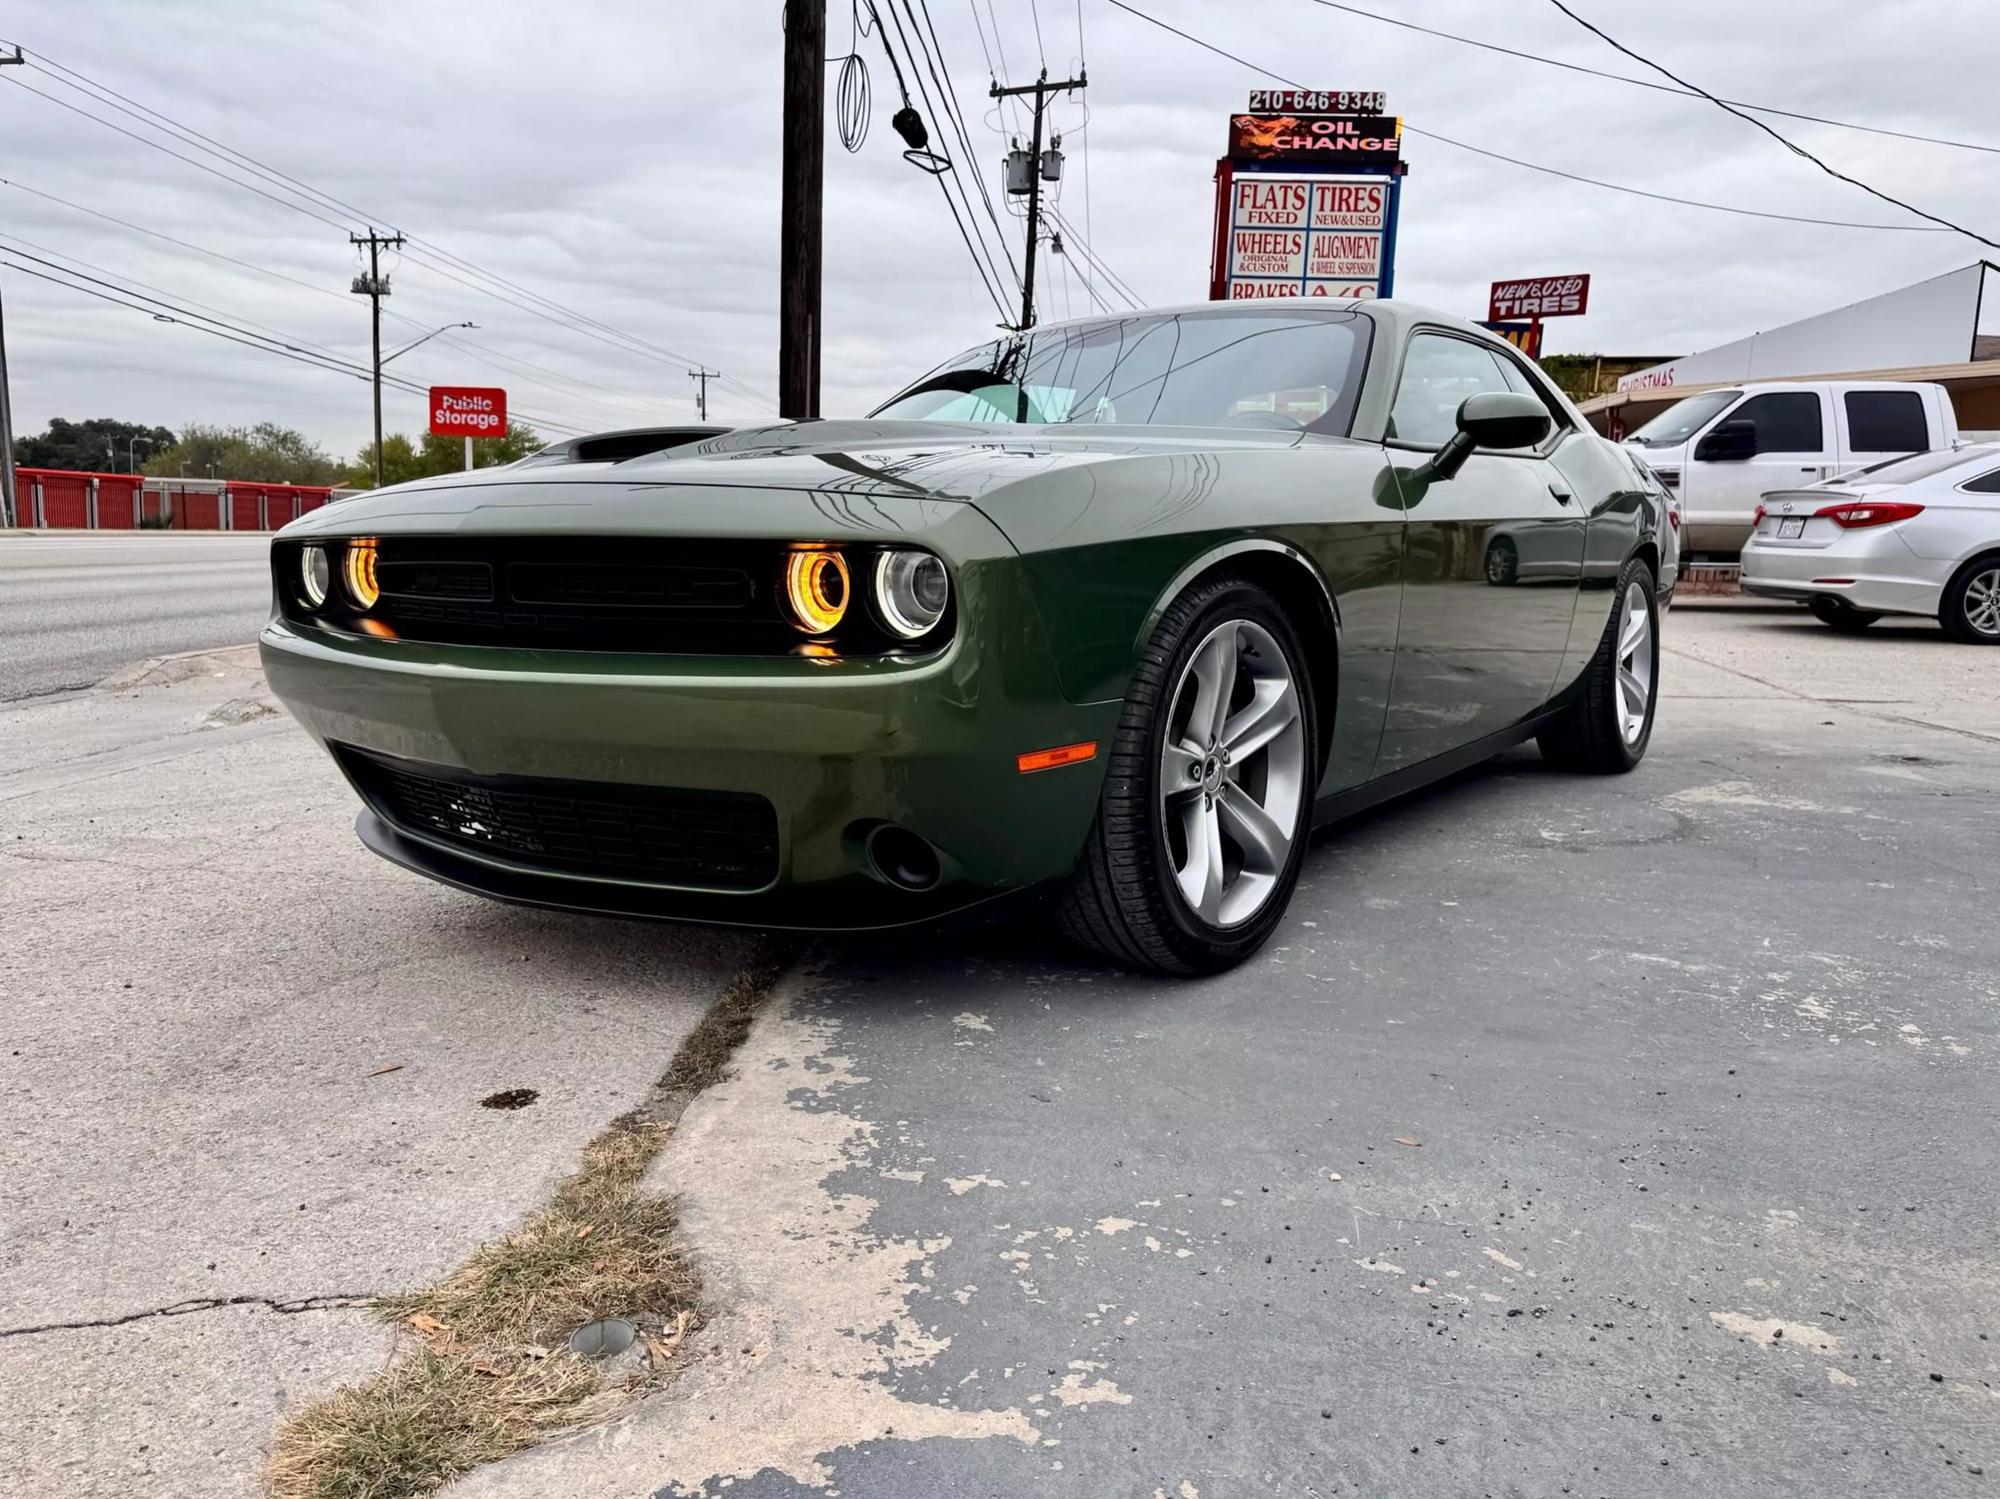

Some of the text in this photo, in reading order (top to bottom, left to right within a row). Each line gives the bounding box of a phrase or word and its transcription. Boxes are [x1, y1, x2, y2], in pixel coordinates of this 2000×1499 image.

[1250, 90, 1387, 111] 210-646-9348
[1311, 121, 1360, 135] OIL
[1273, 136, 1400, 151] CHANGE
[1238, 184, 1306, 211] FLATS
[1316, 186, 1381, 214] TIRES
[1247, 211, 1298, 225] FIXED
[1314, 214, 1381, 227] NEW&USED
[1236, 233, 1302, 256] WHEELS
[1313, 235, 1380, 260] ALIGNMENT
[1242, 255, 1289, 264] ORIGINAL
[1315, 261, 1336, 274] WHEEL
[1337, 262, 1376, 275] SUSPENSION
[1233, 283, 1299, 299] BRAKES
[1494, 294, 1580, 316] TIRES
[442, 394, 493, 411] Public
[435, 409, 500, 430] Storage
